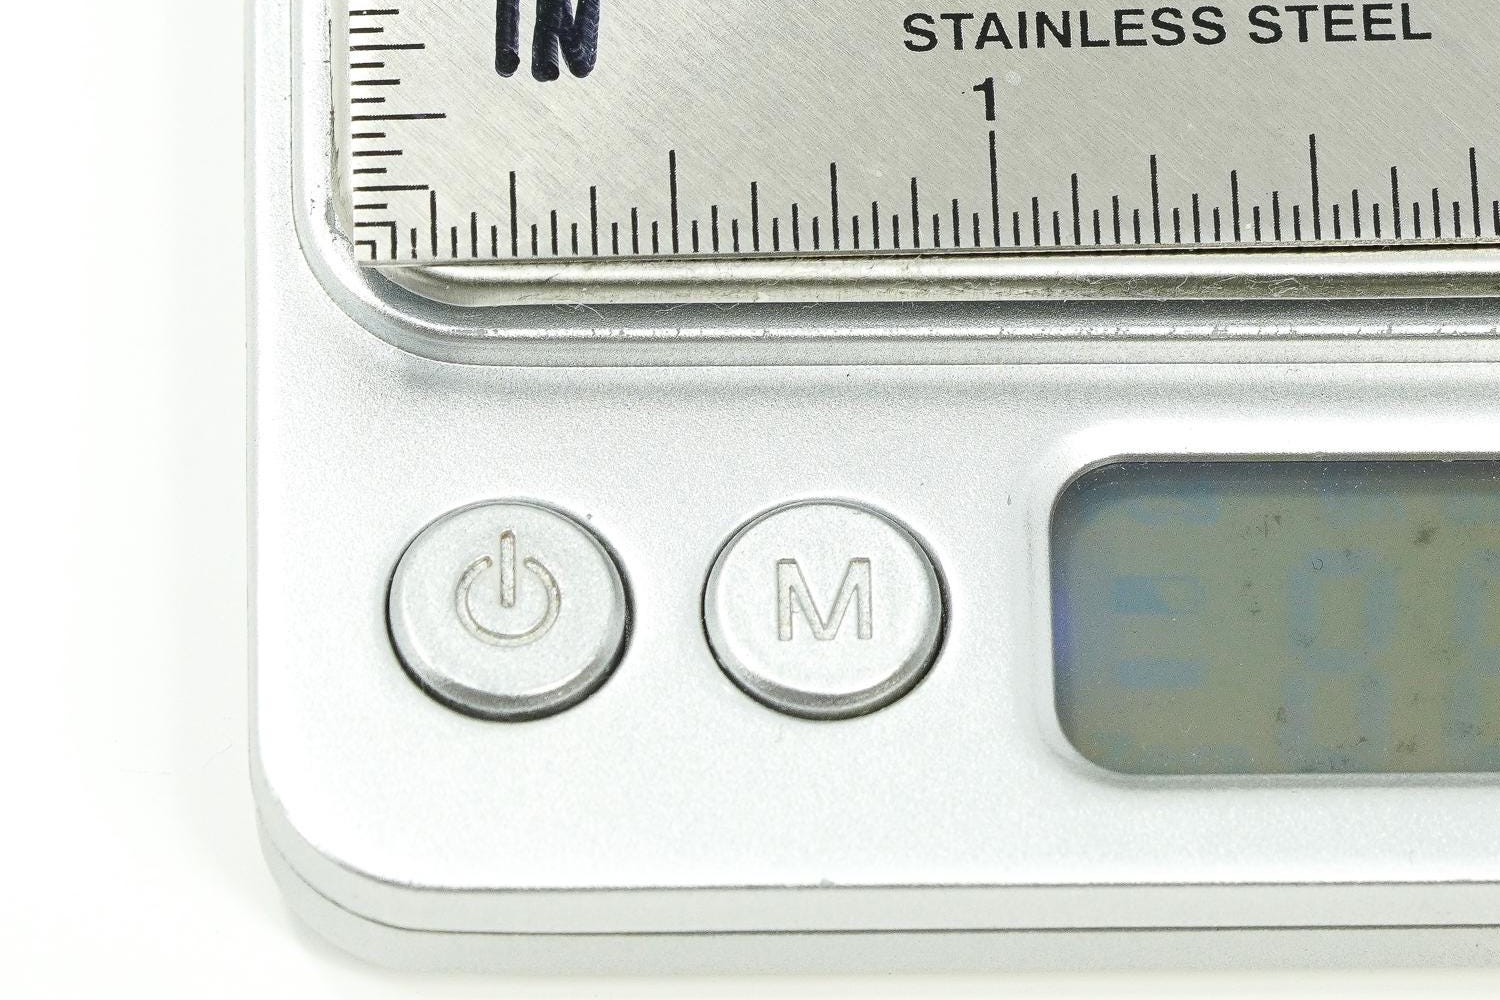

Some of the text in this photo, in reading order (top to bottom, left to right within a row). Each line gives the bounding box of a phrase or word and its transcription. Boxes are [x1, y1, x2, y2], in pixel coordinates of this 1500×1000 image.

[902, 1, 1434, 54] STAINLESS STEEL
[971, 75, 997, 123] 1
[776, 556, 874, 642] M
